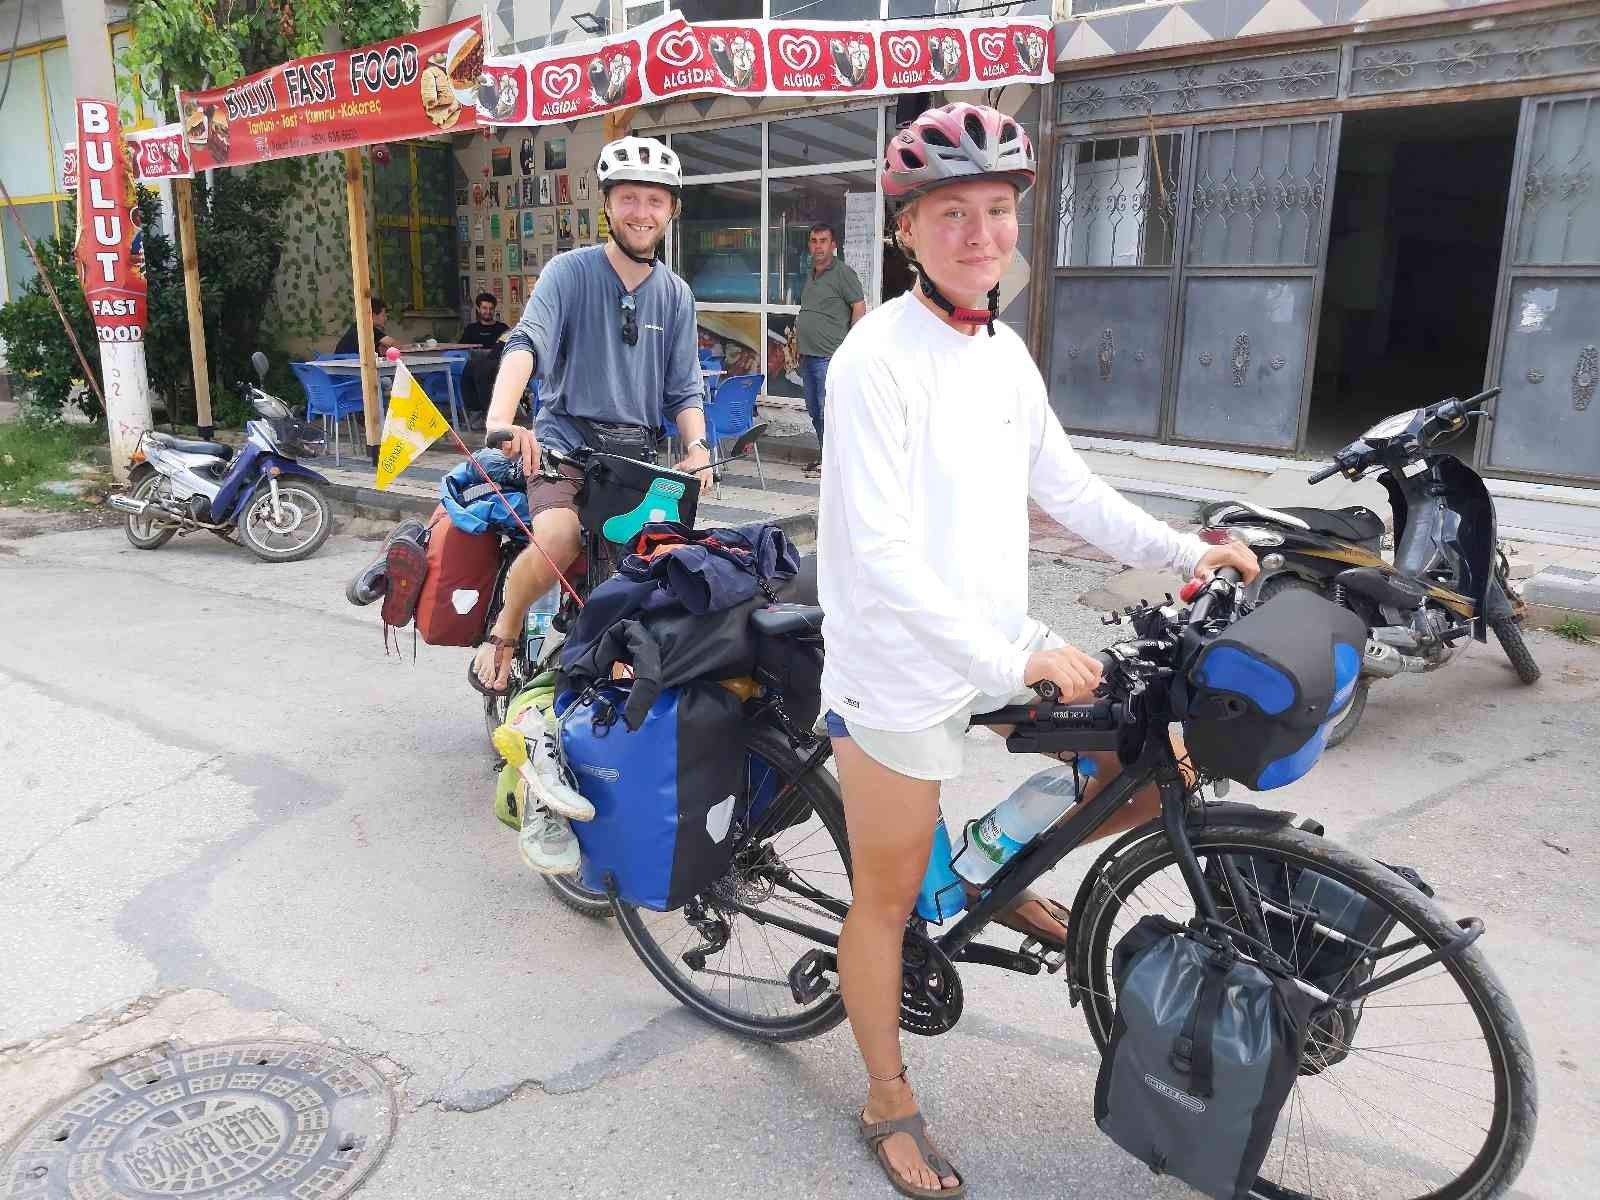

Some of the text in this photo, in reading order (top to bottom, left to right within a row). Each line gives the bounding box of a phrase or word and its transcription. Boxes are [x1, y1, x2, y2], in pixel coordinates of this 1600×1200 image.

[223, 43, 419, 121] BULUT FAST FOOD
[81, 102, 122, 282] BULUT
[91, 299, 136, 316] FAST
[95, 325, 142, 342] FOOD
